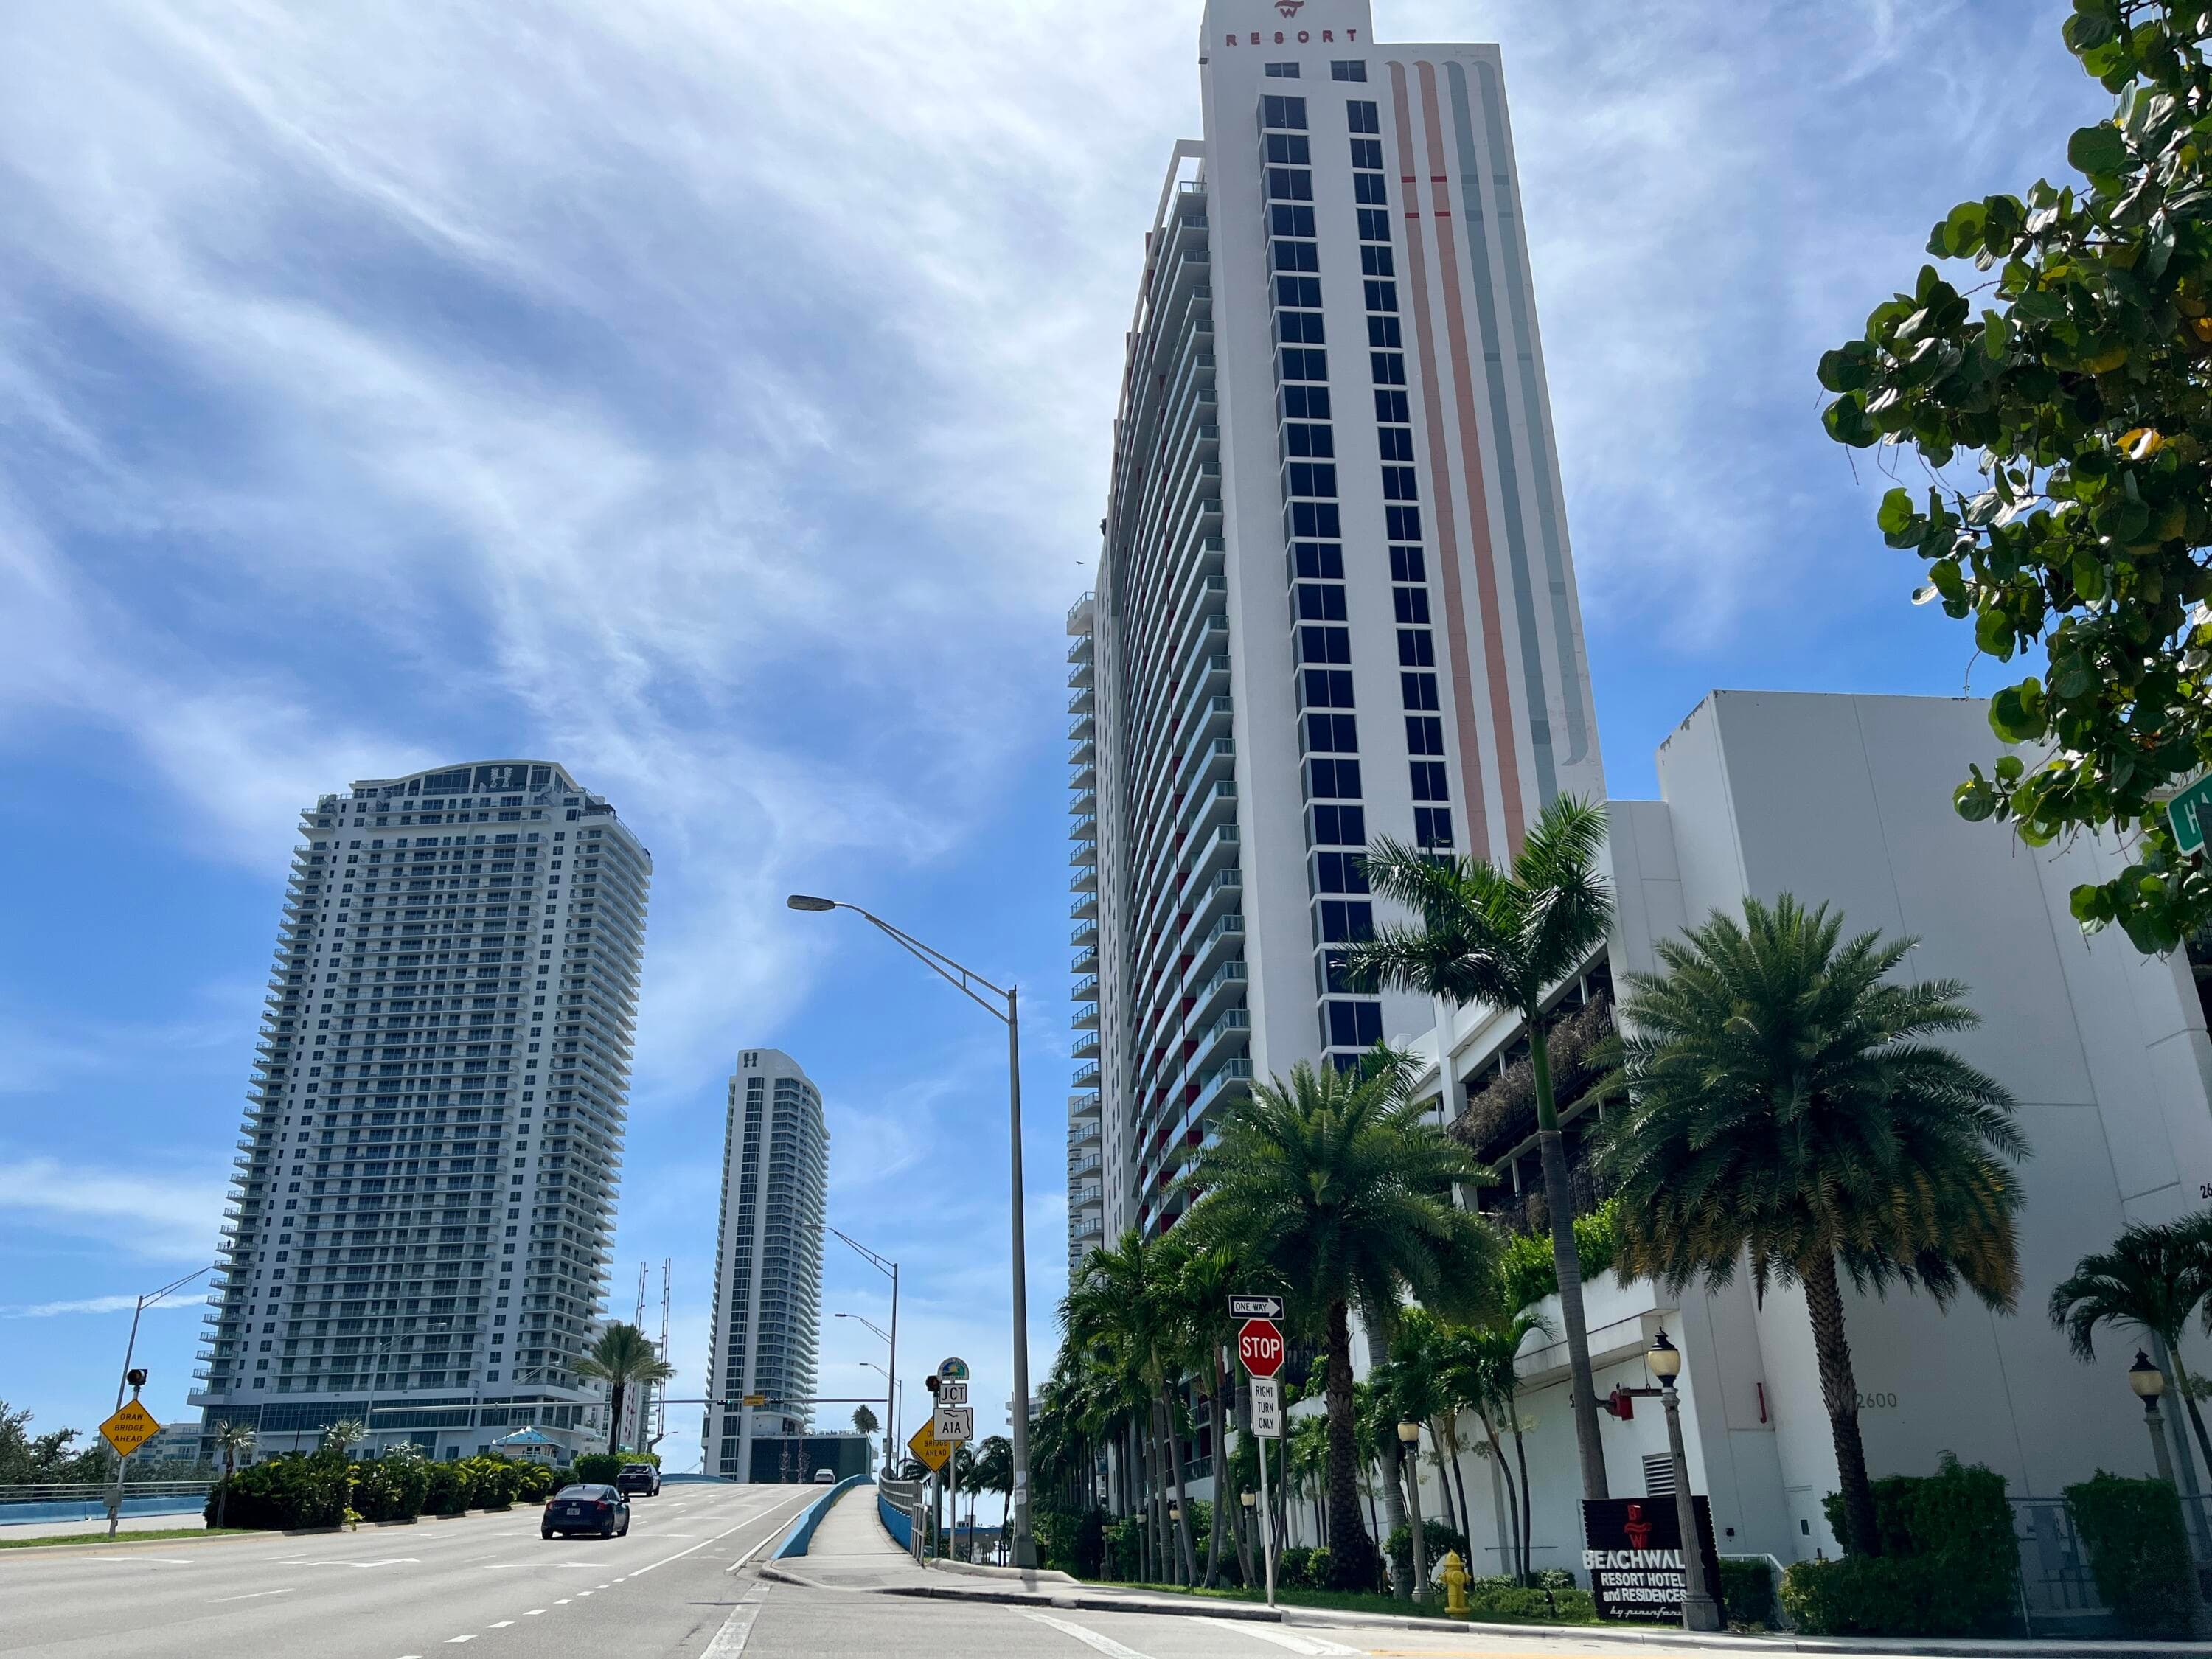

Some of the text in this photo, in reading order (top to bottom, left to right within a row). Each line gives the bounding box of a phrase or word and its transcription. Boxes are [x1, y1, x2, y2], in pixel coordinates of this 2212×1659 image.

[1225, 29, 1357, 47] RESORT
[1235, 1302, 1267, 1312] ONE WAY
[1242, 1336, 1281, 1360] STOP
[941, 1386, 965, 1401] JCT
[1256, 1385, 1273, 1398] RIGHT
[1855, 1392, 1897, 1408] 2600
[1258, 1402, 1274, 1414] TURN
[114, 1424, 145, 1432] BRIDGE
[942, 1421, 961, 1434] A1A
[1259, 1418, 1274, 1430] ONLY
[114, 1435, 143, 1443] AHEAD
[925, 1448, 947, 1457] AHEAD
[1582, 1549, 1686, 1570] BEACHWAL
[1601, 1573, 1686, 1587] RESORT HOTEL
[1603, 1588, 1687, 1604] and RESIDENCES
[1610, 1606, 1624, 1618] by
